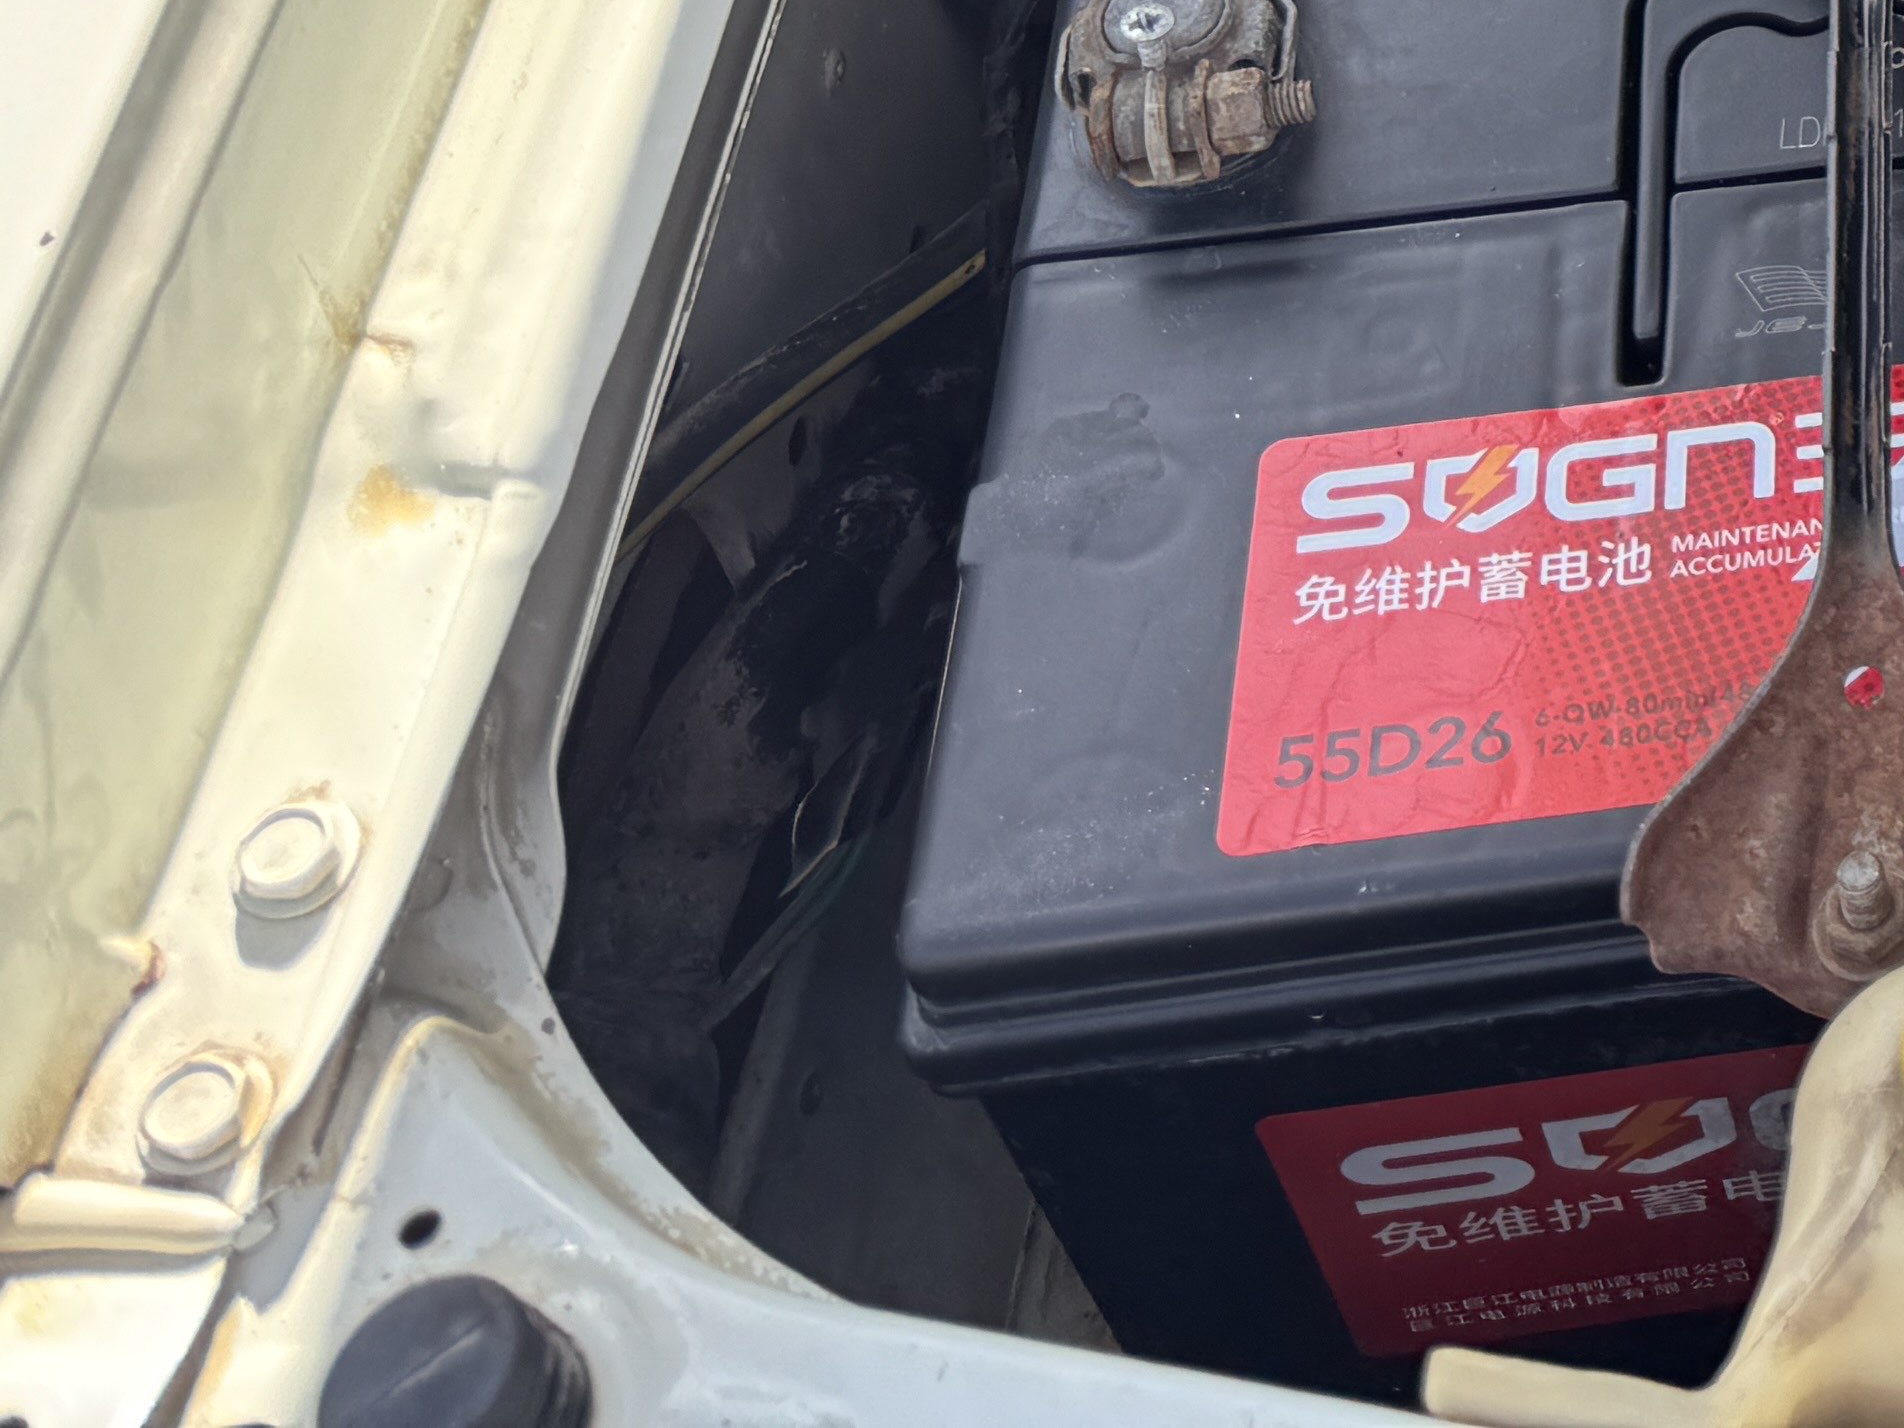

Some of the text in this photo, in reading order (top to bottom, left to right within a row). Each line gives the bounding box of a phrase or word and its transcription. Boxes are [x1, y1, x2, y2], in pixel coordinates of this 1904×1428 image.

[1295, 421, 1775, 553] SOGN
[1670, 541, 1823, 578] ACCUMULA
[1671, 518, 1824, 554] MAINTENAN
[1292, 538, 1653, 625] 免维护蓄电池
[1272, 711, 1513, 789] 55D26
[1537, 731, 1589, 757] 12V
